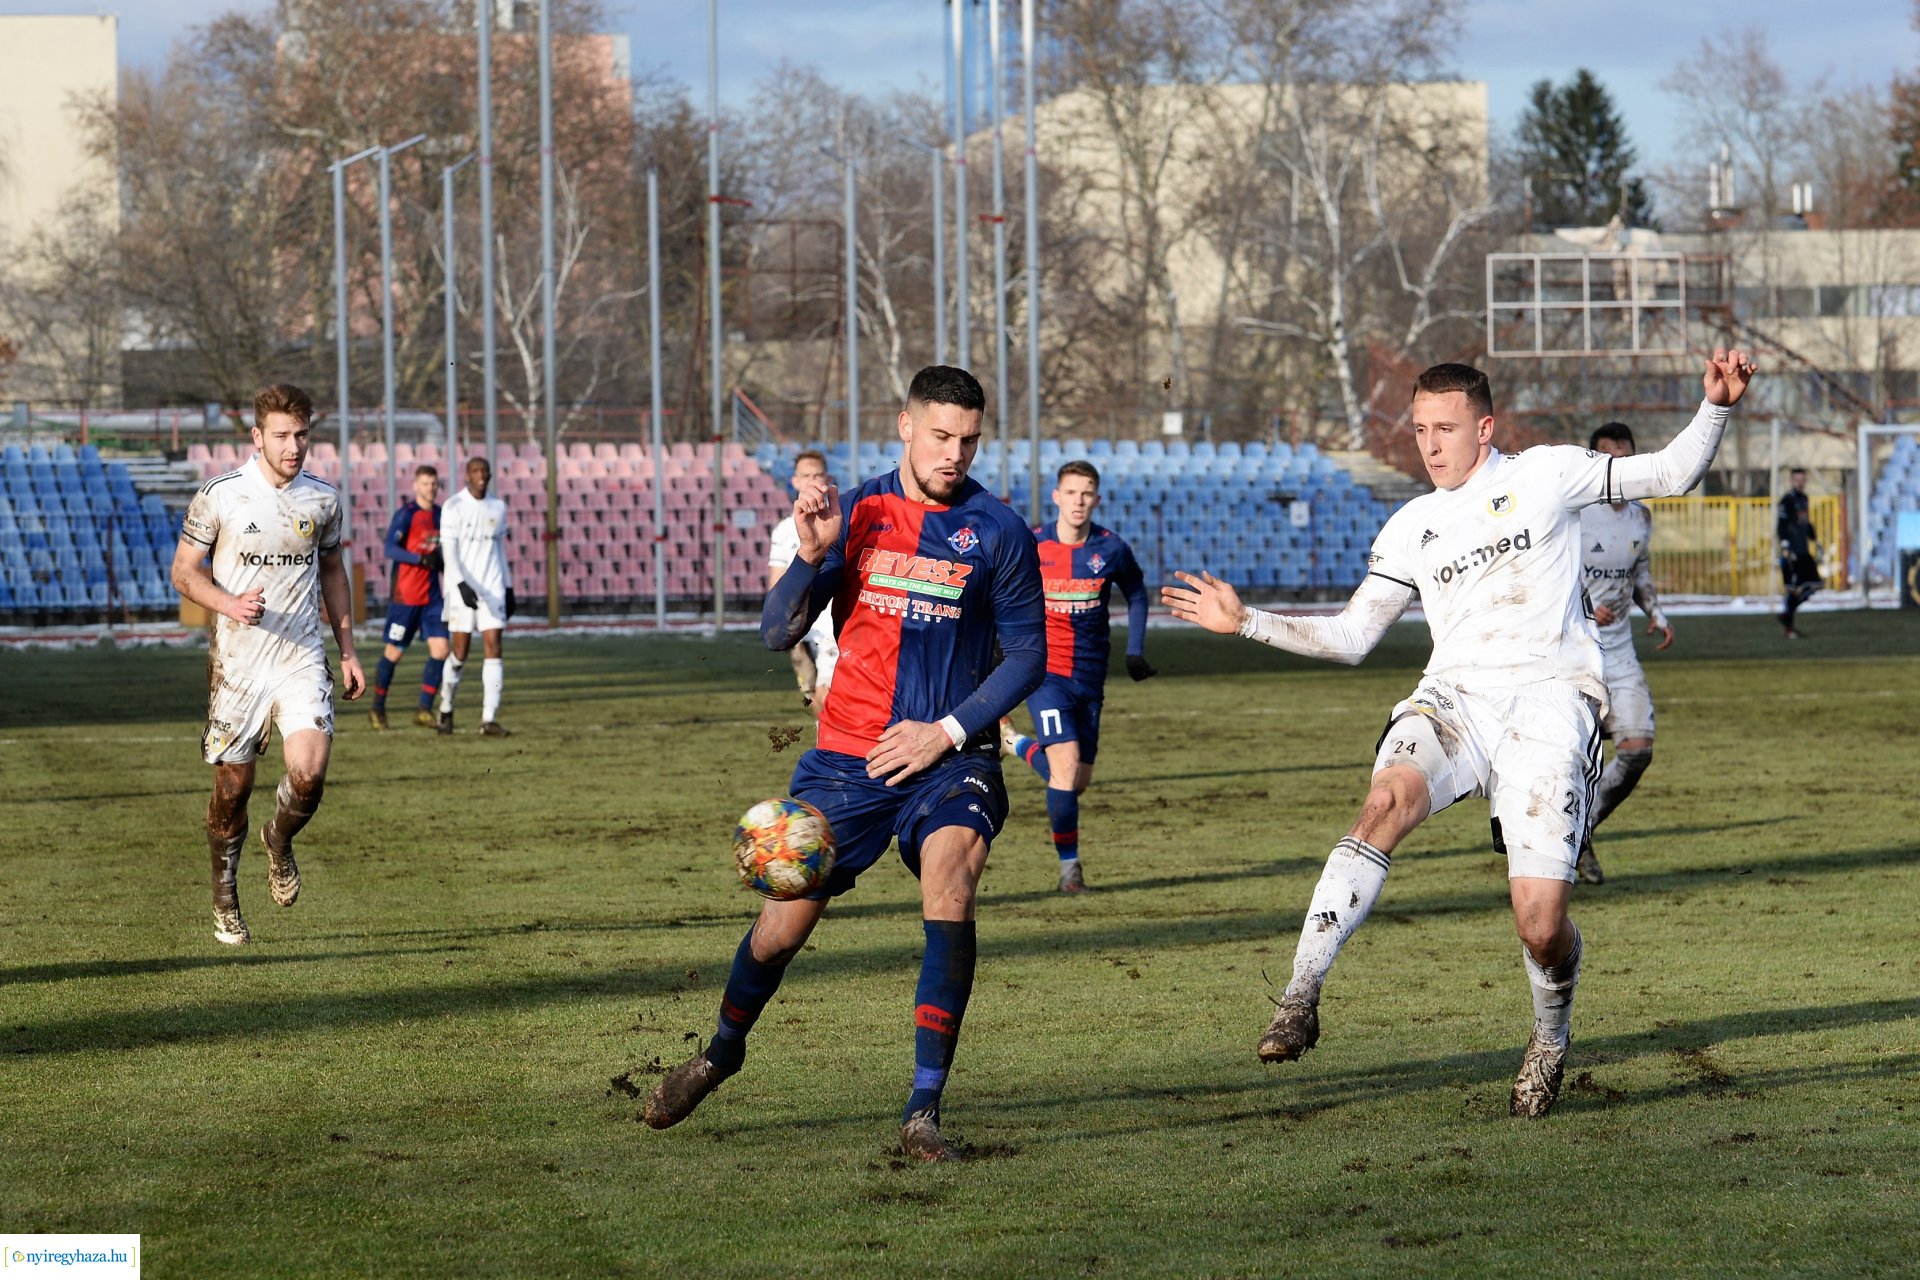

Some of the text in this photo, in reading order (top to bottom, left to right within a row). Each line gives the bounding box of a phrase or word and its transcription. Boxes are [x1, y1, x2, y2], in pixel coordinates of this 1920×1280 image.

[857, 547, 973, 588] REVESZ
[870, 576, 898, 586] ALWAYS
[908, 582, 922, 590] THE
[922, 584, 943, 593] RIGHT
[943, 588, 960, 597] WAY
[911, 600, 962, 619] TRANS
[1394, 740, 1417, 755] 24
[963, 776, 989, 793] JAKO
[1562, 789, 1581, 824] 24
